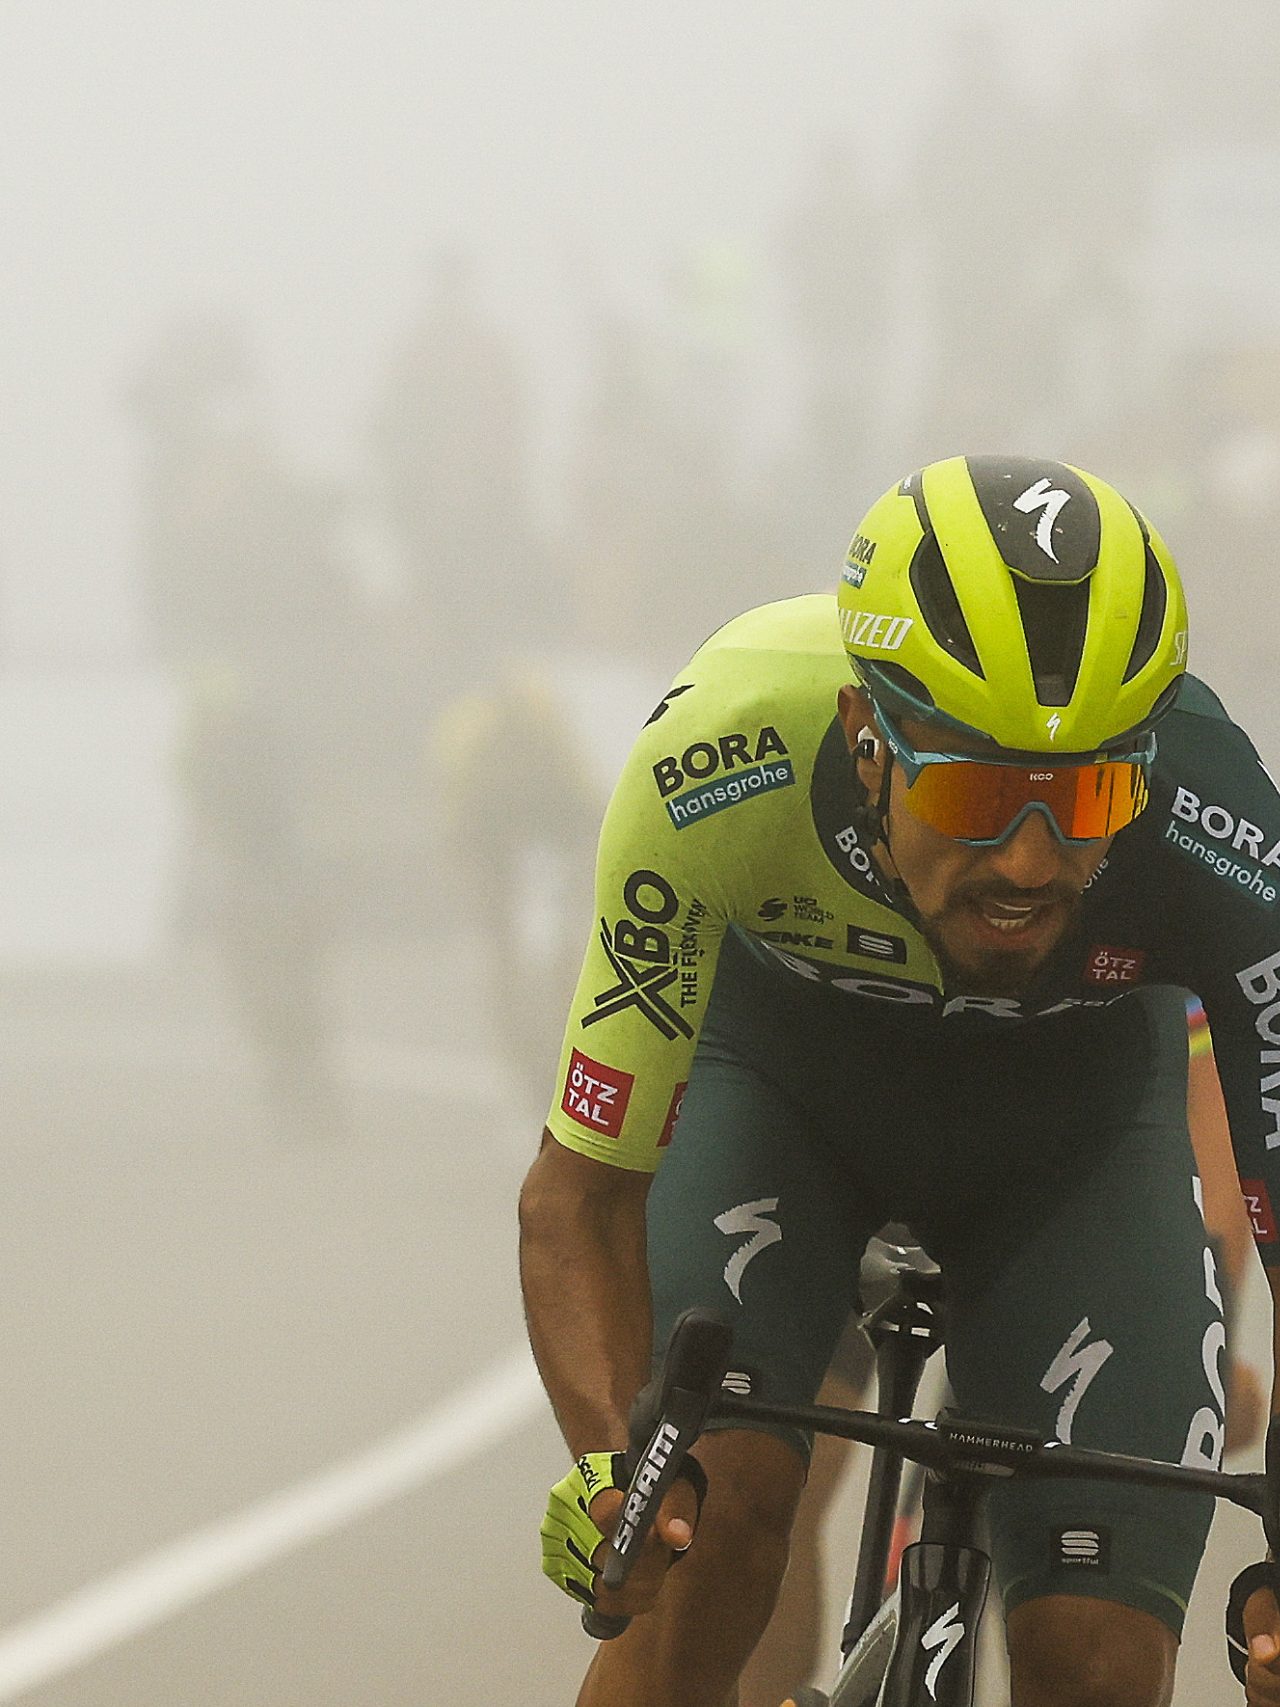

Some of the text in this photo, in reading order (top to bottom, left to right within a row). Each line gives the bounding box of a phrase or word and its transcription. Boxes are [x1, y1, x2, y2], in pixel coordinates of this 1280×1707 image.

[652, 726, 789, 798] BORA
[670, 765, 788, 822] hansgrohe
[1165, 821, 1277, 902] hansgrohe
[1092, 968, 1131, 980] TAL
[1094, 951, 1136, 969] ÖTZ
[681, 971, 697, 1008] THE
[571, 1062, 618, 1105] ÖTZ
[569, 1088, 609, 1126] TAL
[949, 1432, 1033, 1453] HAMMERHEAD
[611, 1423, 680, 1555] SRAM
